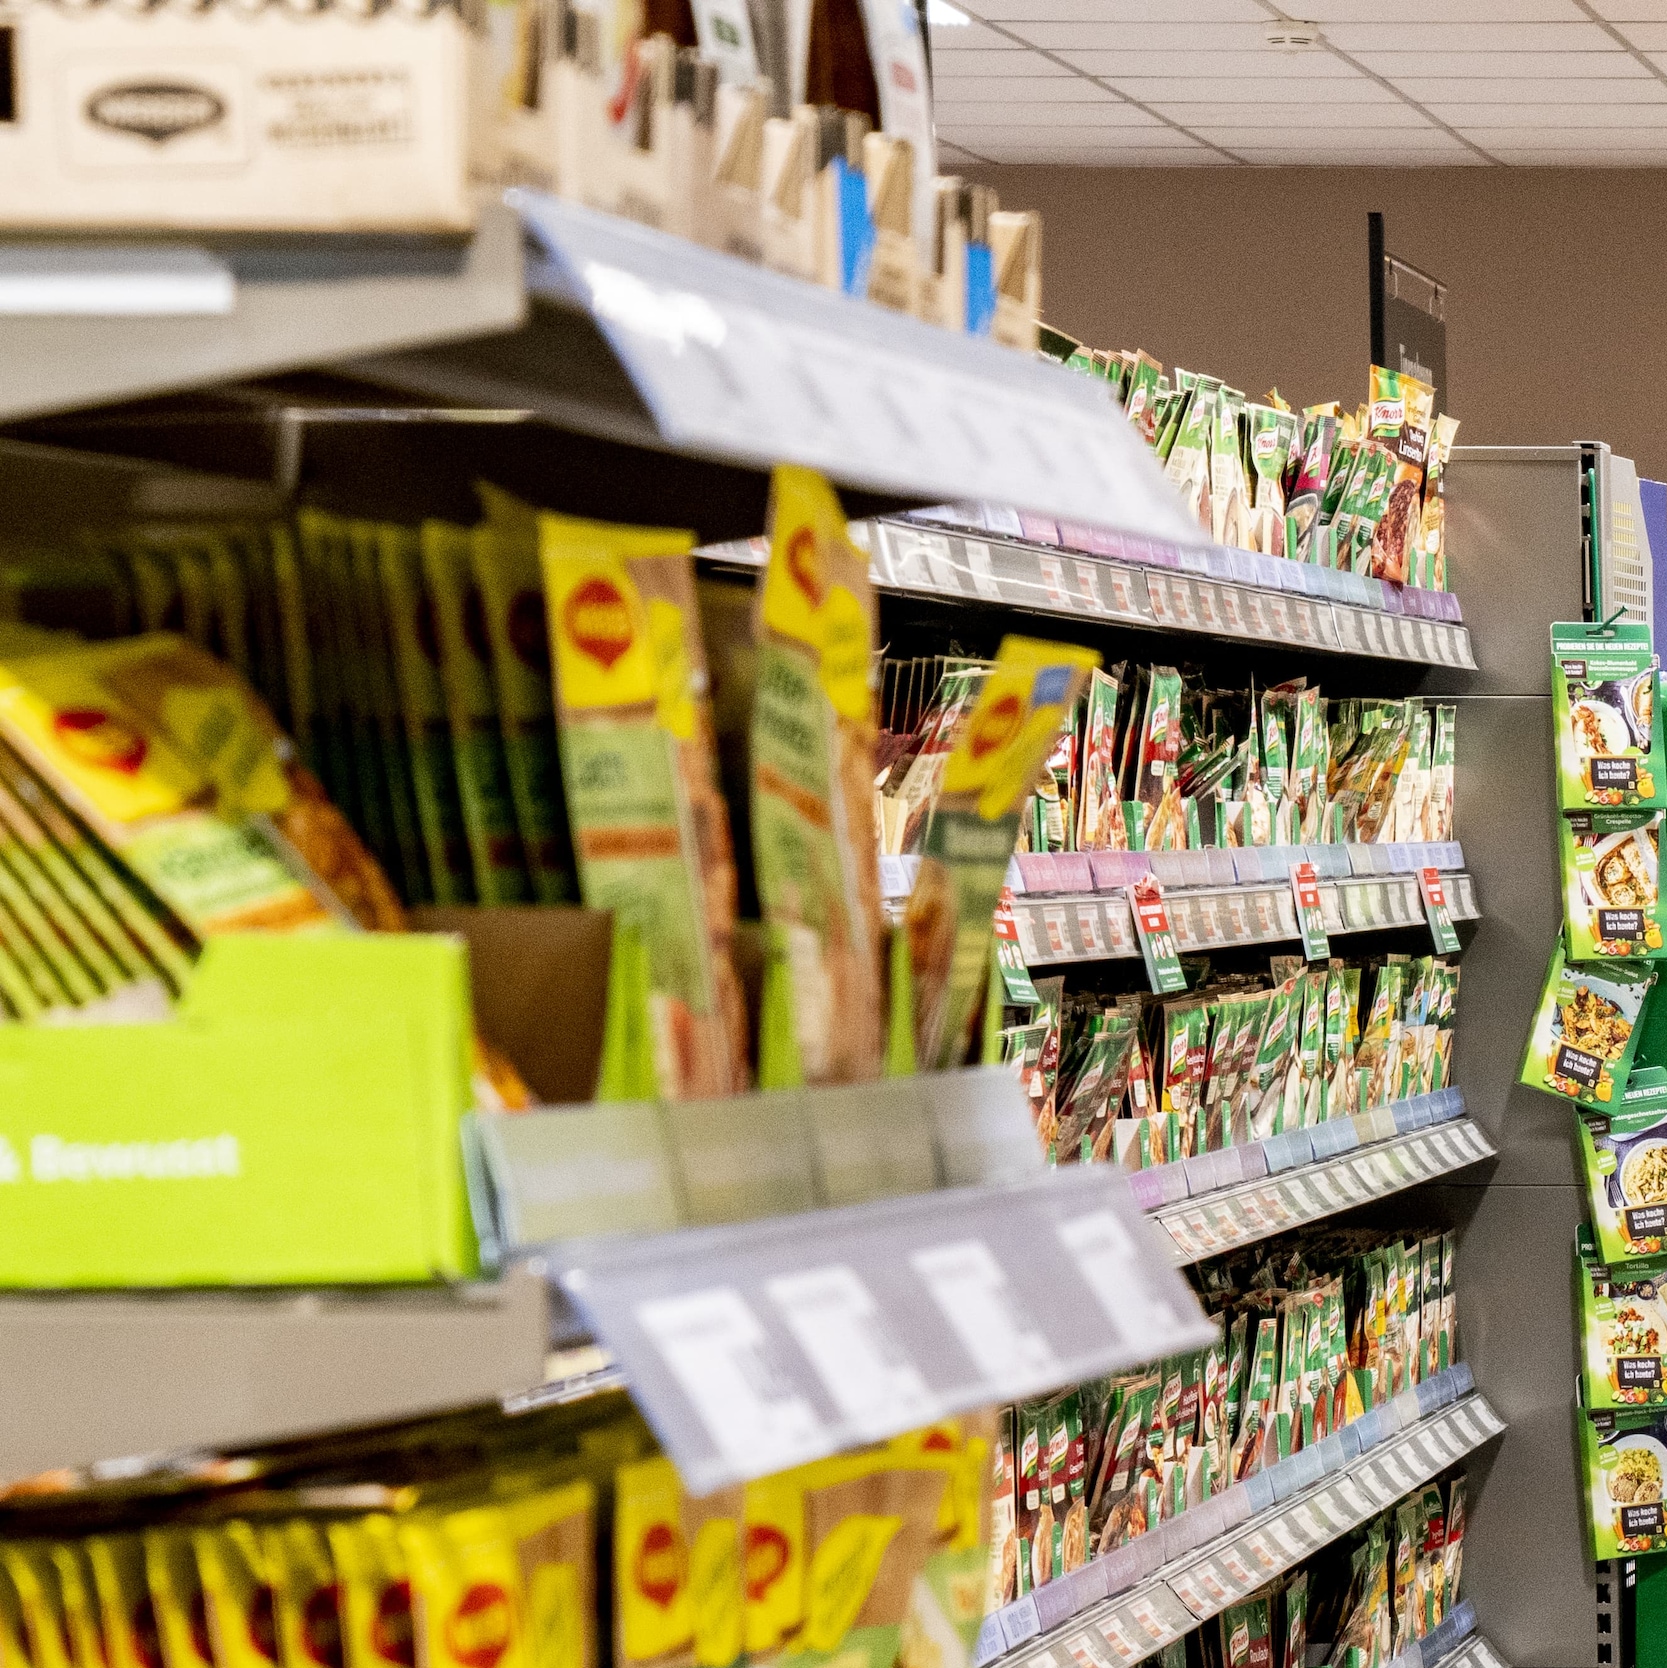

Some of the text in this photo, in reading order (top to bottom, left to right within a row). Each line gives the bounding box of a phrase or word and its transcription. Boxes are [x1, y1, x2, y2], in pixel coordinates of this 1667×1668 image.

[1597, 761, 1630, 770] Was koche
[1610, 771, 1630, 780] heute?
[1605, 912, 1638, 921] Was koche
[1618, 921, 1638, 930] heute?
[1623, 1359, 1656, 1370] Was koche
[1635, 1369, 1655, 1379] heute?
[1627, 1506, 1658, 1518] Was koche
[1638, 1516, 1658, 1527] heute?
